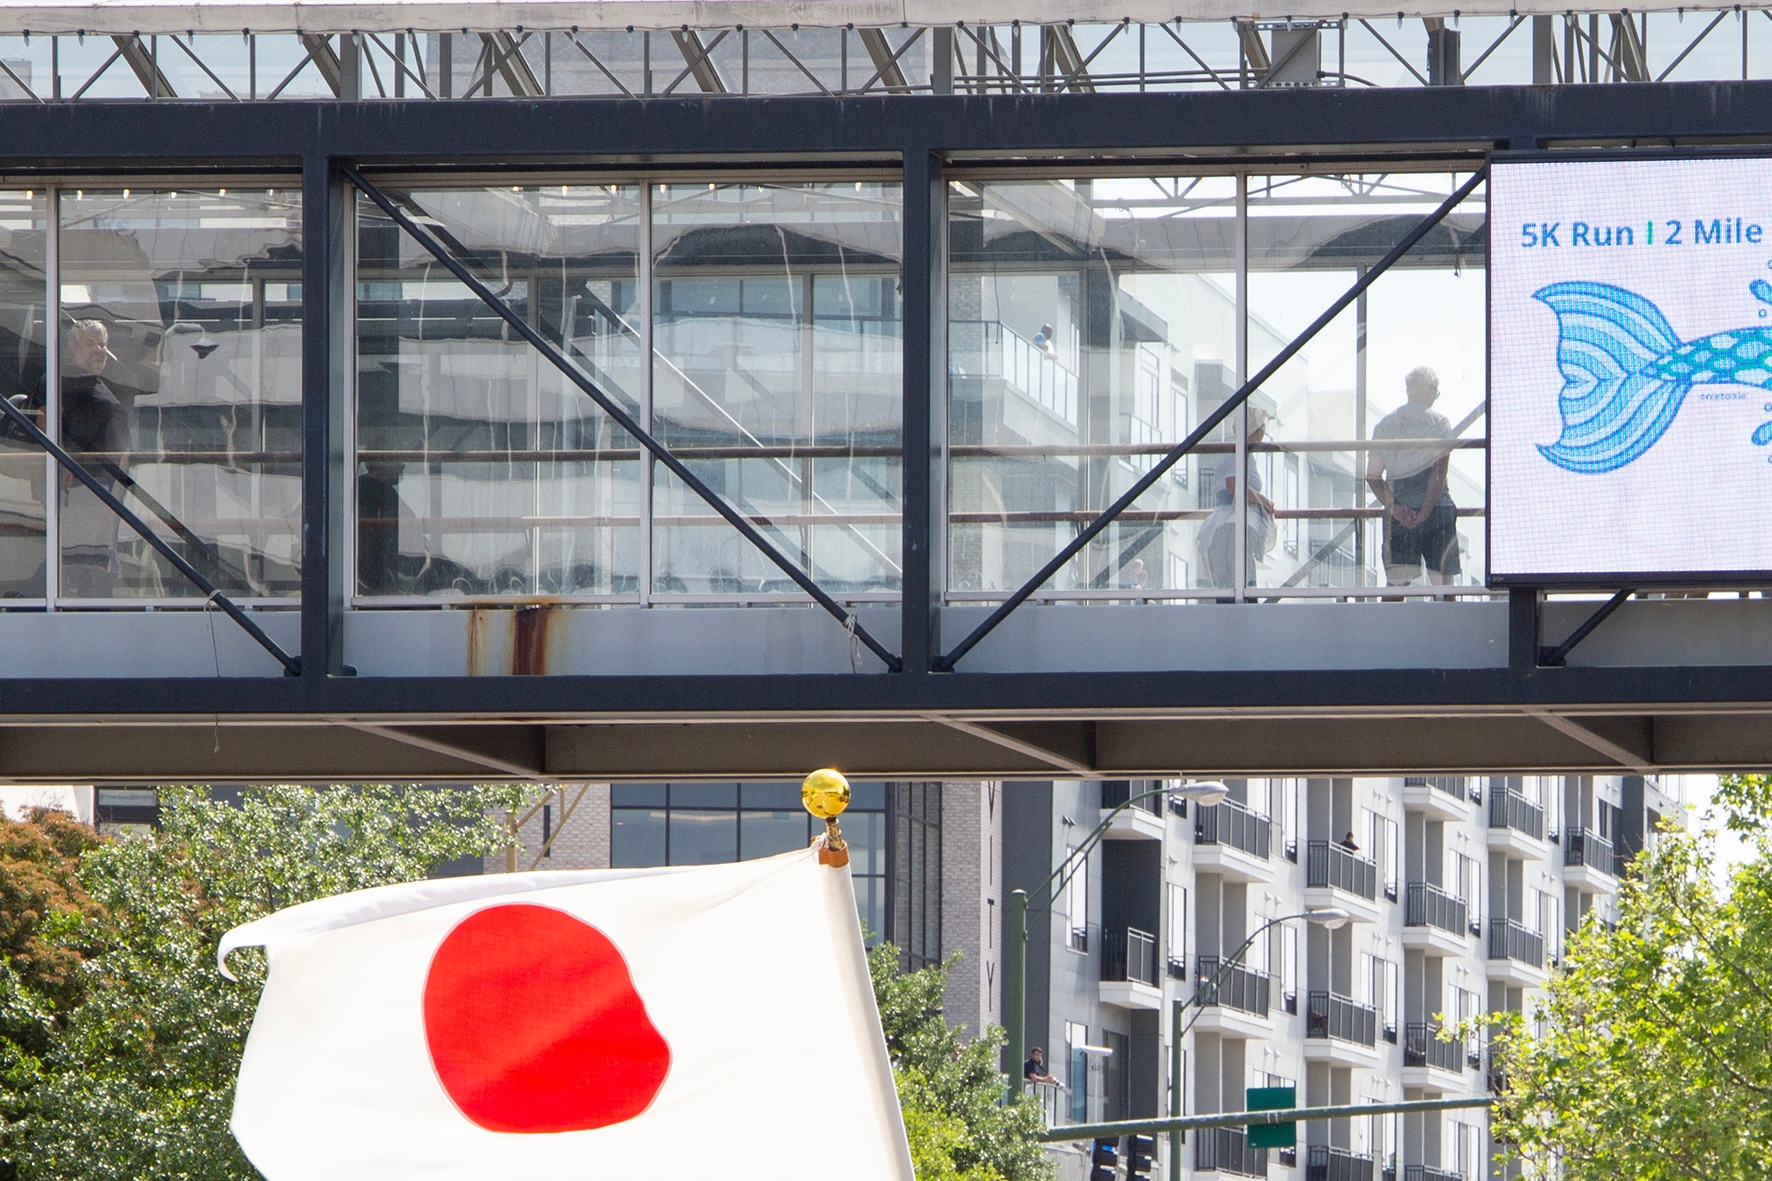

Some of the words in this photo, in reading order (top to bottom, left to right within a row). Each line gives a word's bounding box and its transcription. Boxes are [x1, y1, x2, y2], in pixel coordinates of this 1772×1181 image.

[1521, 222, 1561, 248] 5K
[1571, 222, 1634, 247] Run
[1664, 220, 1684, 246] 2
[1694, 216, 1763, 245] Mile
